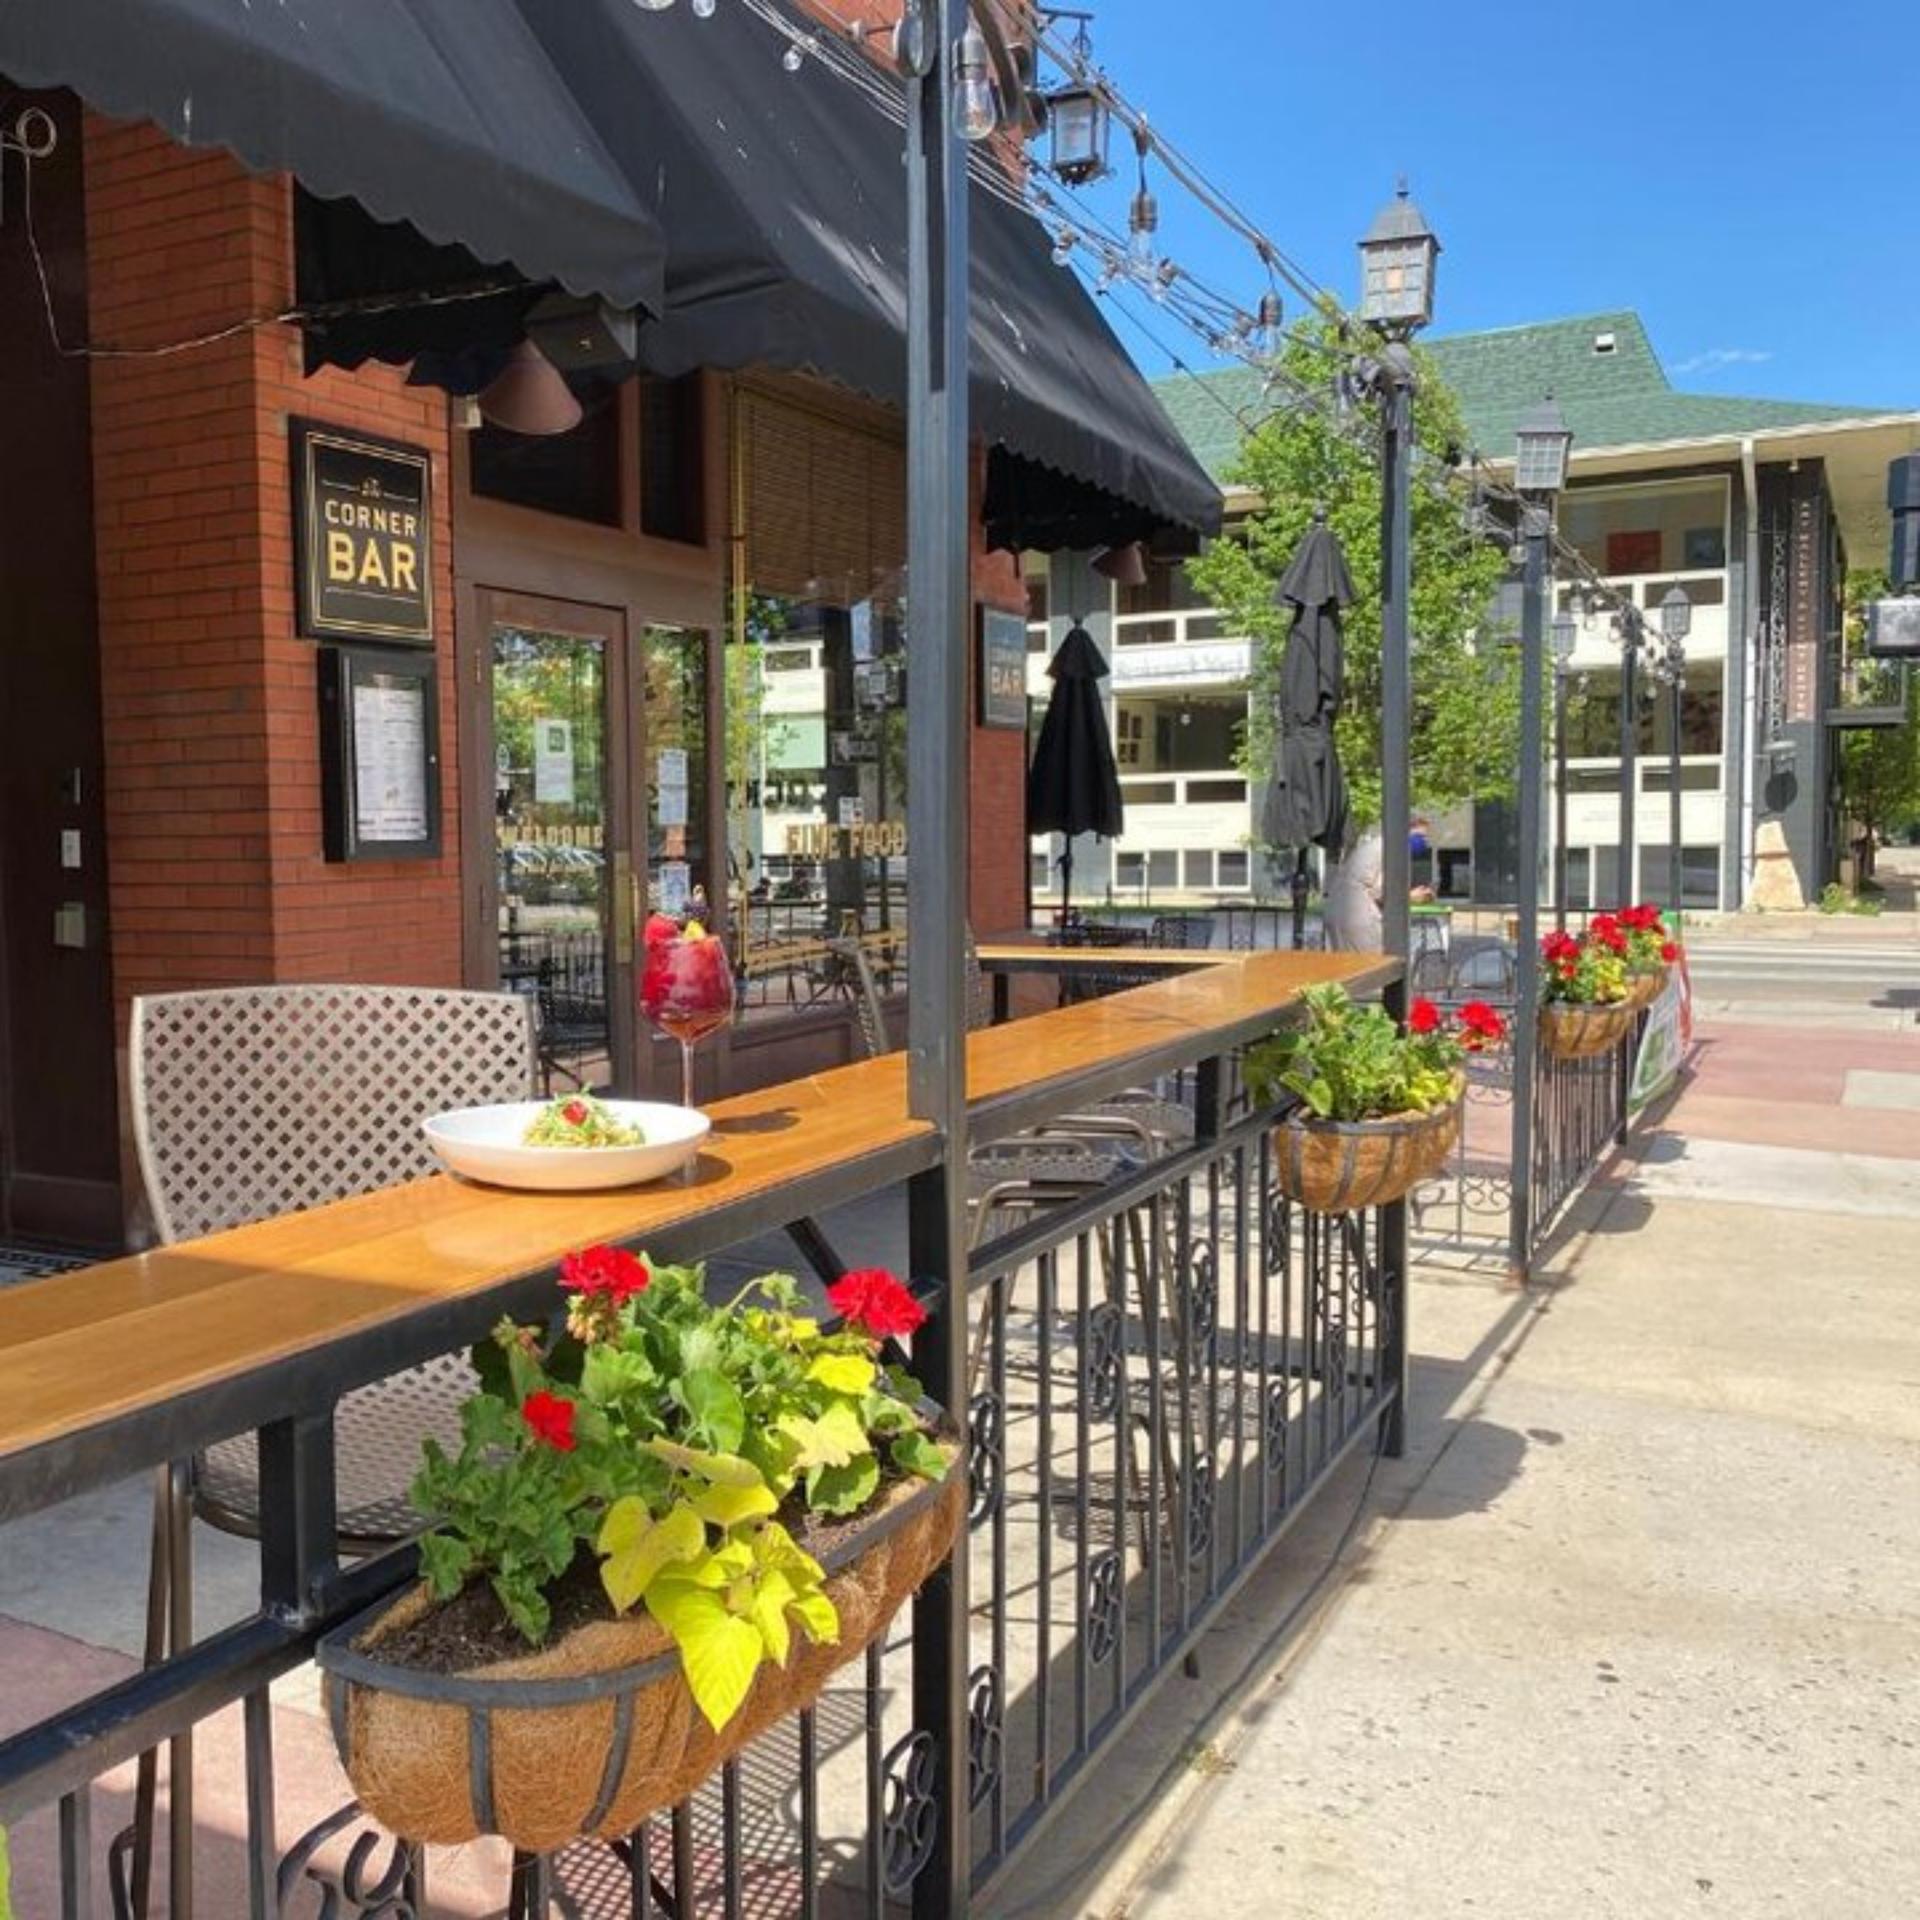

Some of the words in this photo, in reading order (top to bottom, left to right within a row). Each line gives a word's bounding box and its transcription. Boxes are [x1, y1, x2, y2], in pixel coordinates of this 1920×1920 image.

[325, 500, 416, 537] CORNER
[327, 530, 417, 592] BAR
[991, 665, 1024, 697] BAR
